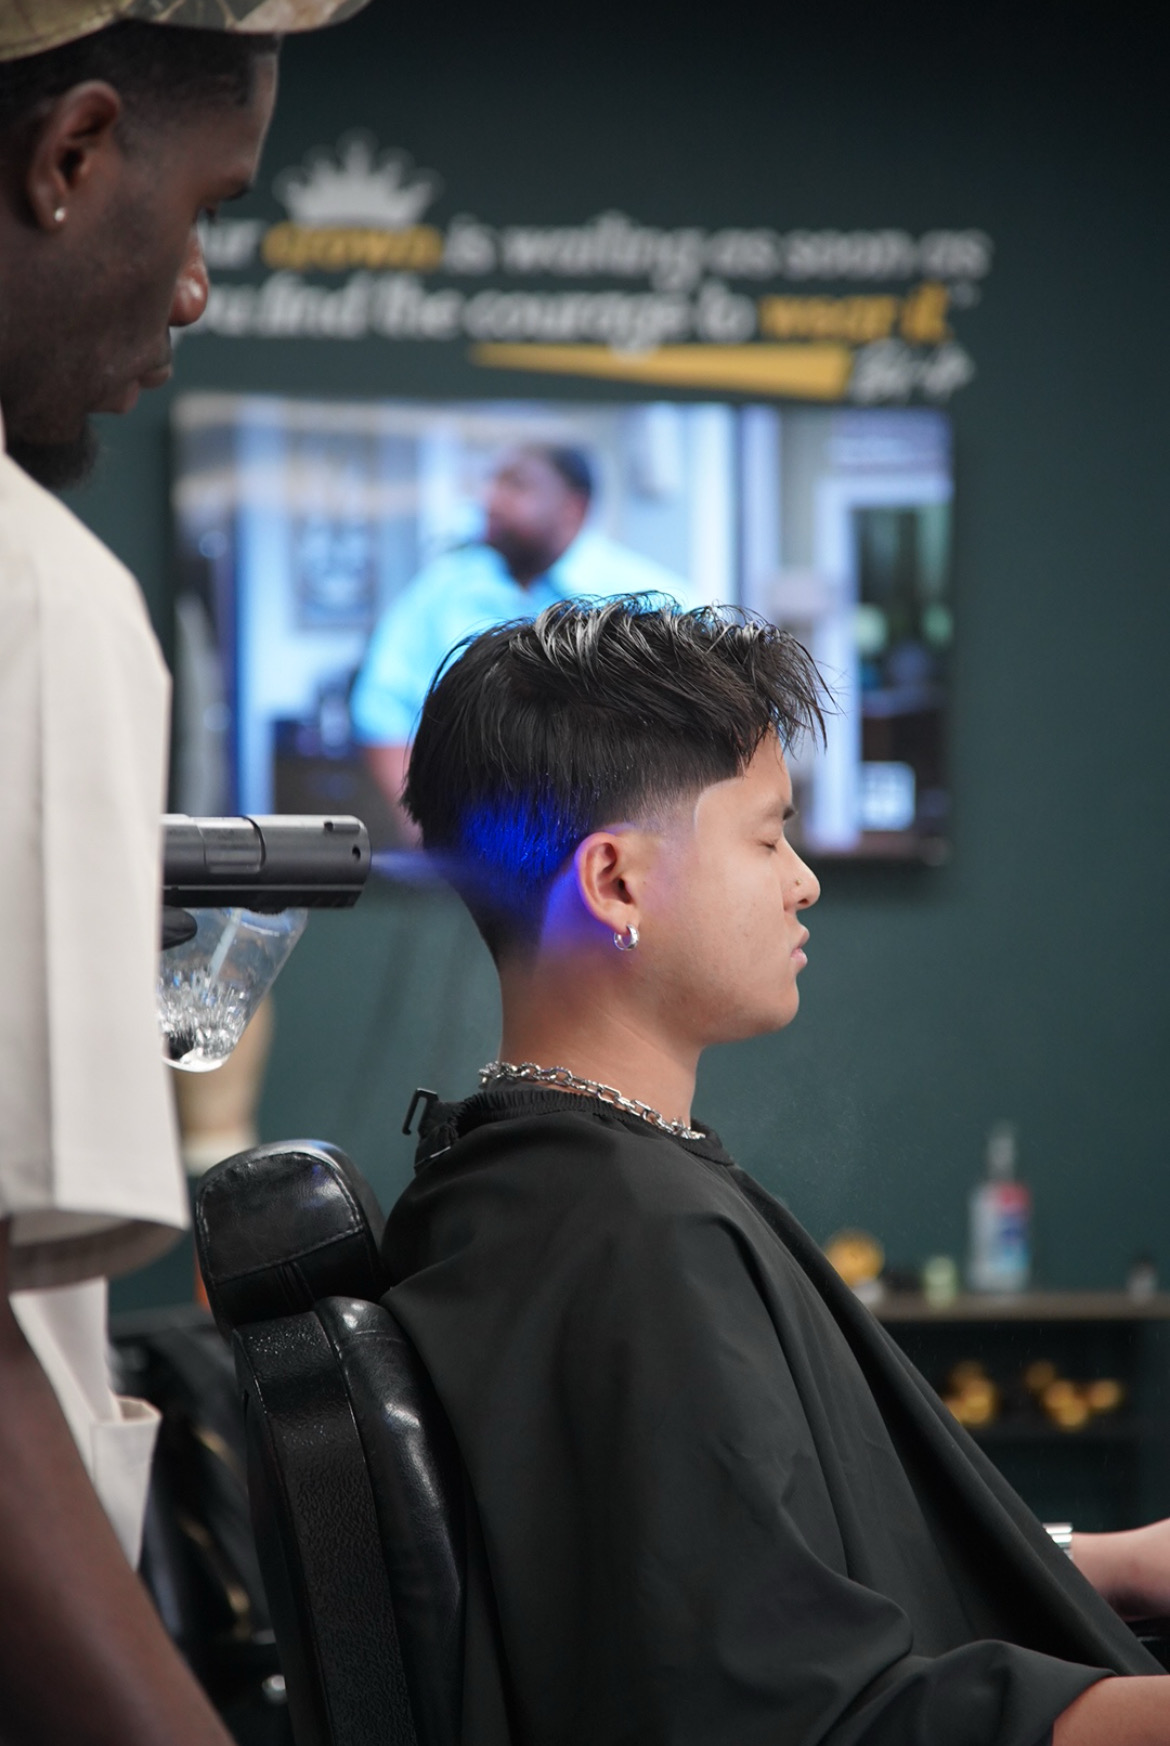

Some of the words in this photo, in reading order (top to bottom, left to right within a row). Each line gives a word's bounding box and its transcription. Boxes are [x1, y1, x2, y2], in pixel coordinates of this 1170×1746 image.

[266, 224, 441, 271] crown
[447, 217, 492, 271] is
[503, 214, 702, 291] waiting
[711, 229, 777, 277] as
[785, 230, 911, 277] soon
[921, 230, 988, 278] as
[261, 274, 370, 337] find
[377, 274, 461, 338] the
[467, 292, 690, 360] courage
[698, 282, 754, 341] to
[761, 297, 896, 341] wear
